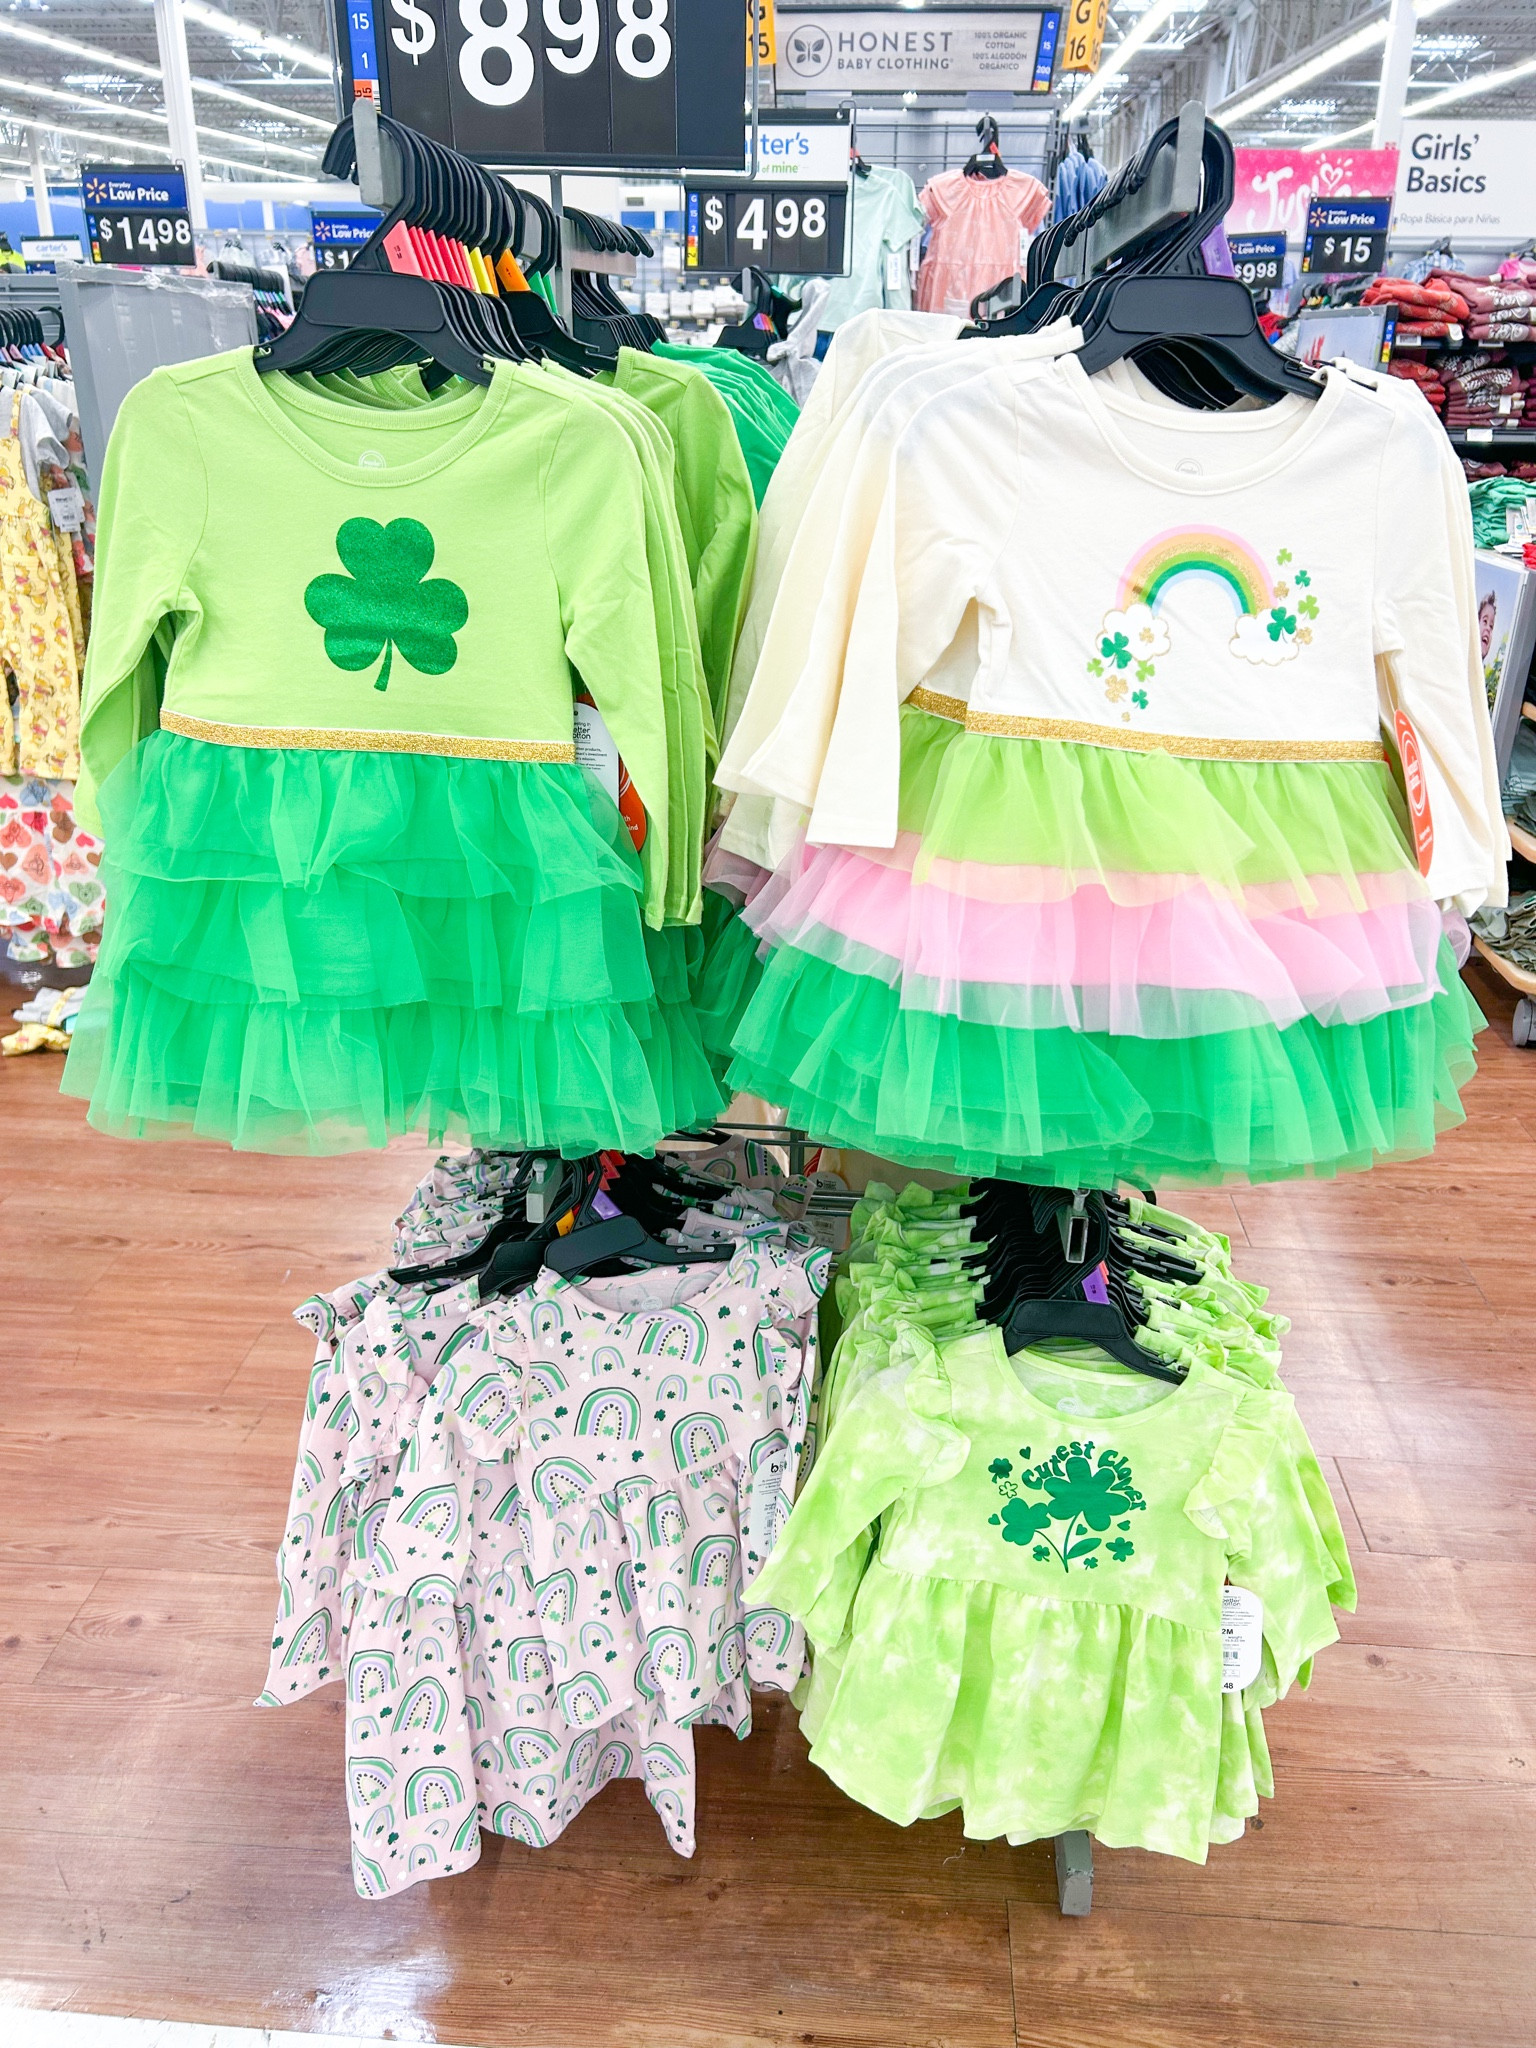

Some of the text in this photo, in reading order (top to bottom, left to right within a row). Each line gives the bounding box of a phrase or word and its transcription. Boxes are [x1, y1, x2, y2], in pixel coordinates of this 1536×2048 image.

[1076, 0, 1091, 24] G
[352, 13, 370, 30] 15
[838, 32, 953, 53] HONEST
[994, 31, 1027, 39] ORGANIC
[1069, 35, 1086, 61] 16
[361, 52, 369, 69] 1
[837, 58, 872, 70] BABY
[1411, 133, 1480, 161] Girls'
[771, 161, 799, 174] mine
[1406, 166, 1487, 194] Basics
[109, 187, 169, 201] Low Price
[1328, 213, 1375, 224] Low Price
[332, 226, 352, 239] Low
[1021, 1441, 1147, 1511] Cutest Clover
